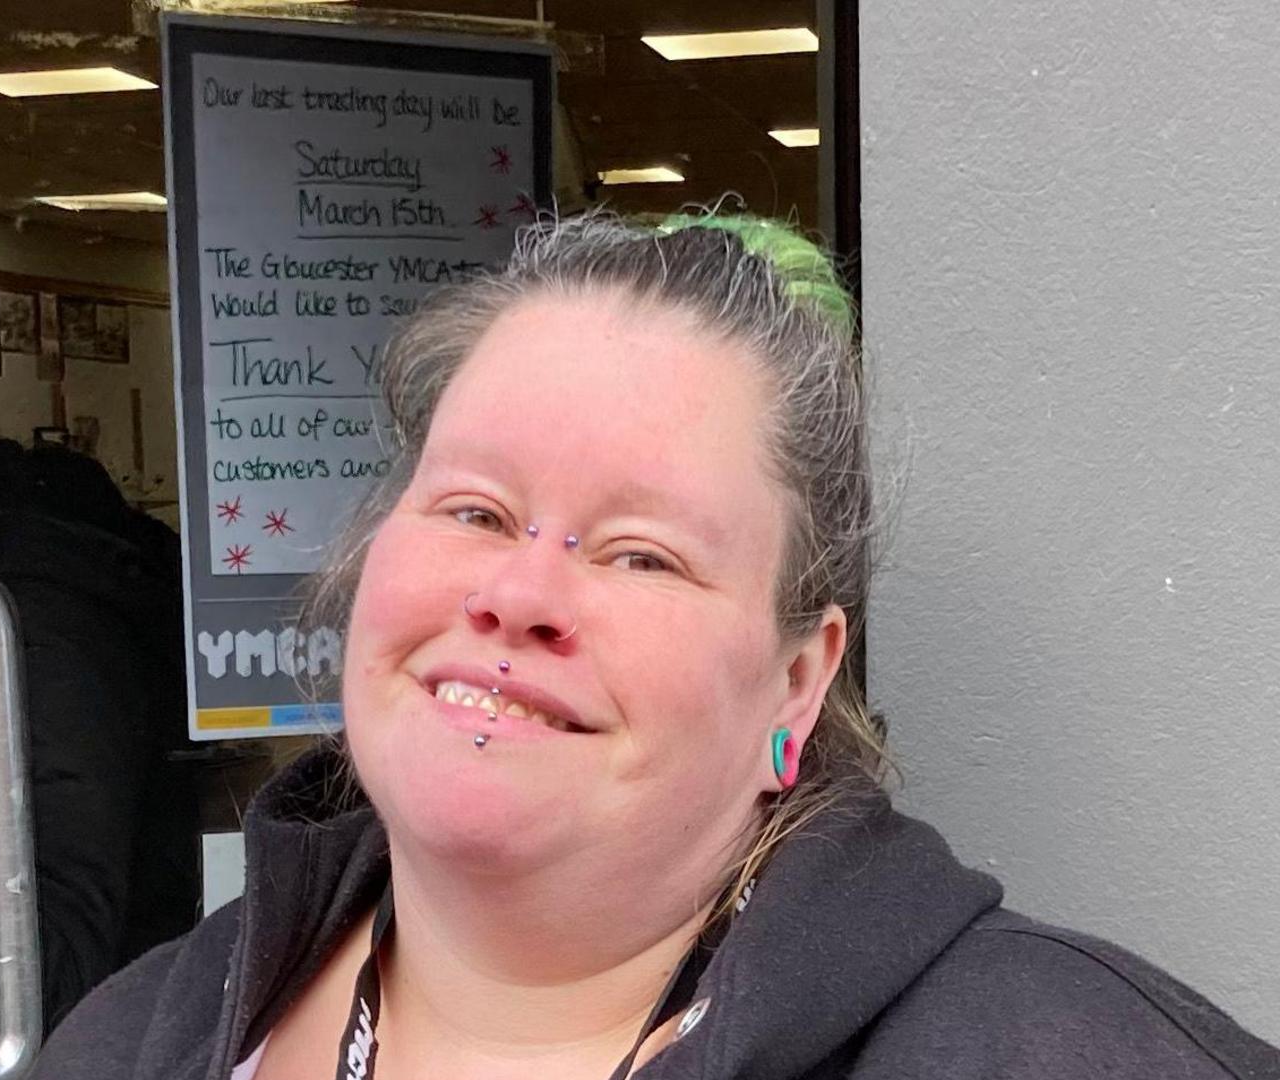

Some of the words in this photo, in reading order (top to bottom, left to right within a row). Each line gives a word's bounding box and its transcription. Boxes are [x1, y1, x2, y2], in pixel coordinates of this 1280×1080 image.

[203, 77, 243, 108] Our
[252, 80, 296, 110] last
[301, 86, 389, 129] trading
[392, 89, 434, 133] day
[440, 95, 481, 121] will
[492, 97, 523, 126] be
[294, 141, 423, 192] Saturday
[298, 188, 382, 227] March
[204, 248, 252, 280] The
[260, 252, 380, 282] Gloucester
[388, 255, 456, 285] YMCA
[211, 290, 279, 319] Would
[295, 289, 339, 318] like
[347, 291, 371, 317] to
[210, 337, 334, 388] Thank
[210, 408, 243, 439] to
[250, 413, 287, 438] all
[297, 410, 329, 441] of
[332, 417, 374, 438] our
[213, 456, 331, 482] customers
[197, 626, 343, 679] YMCA
